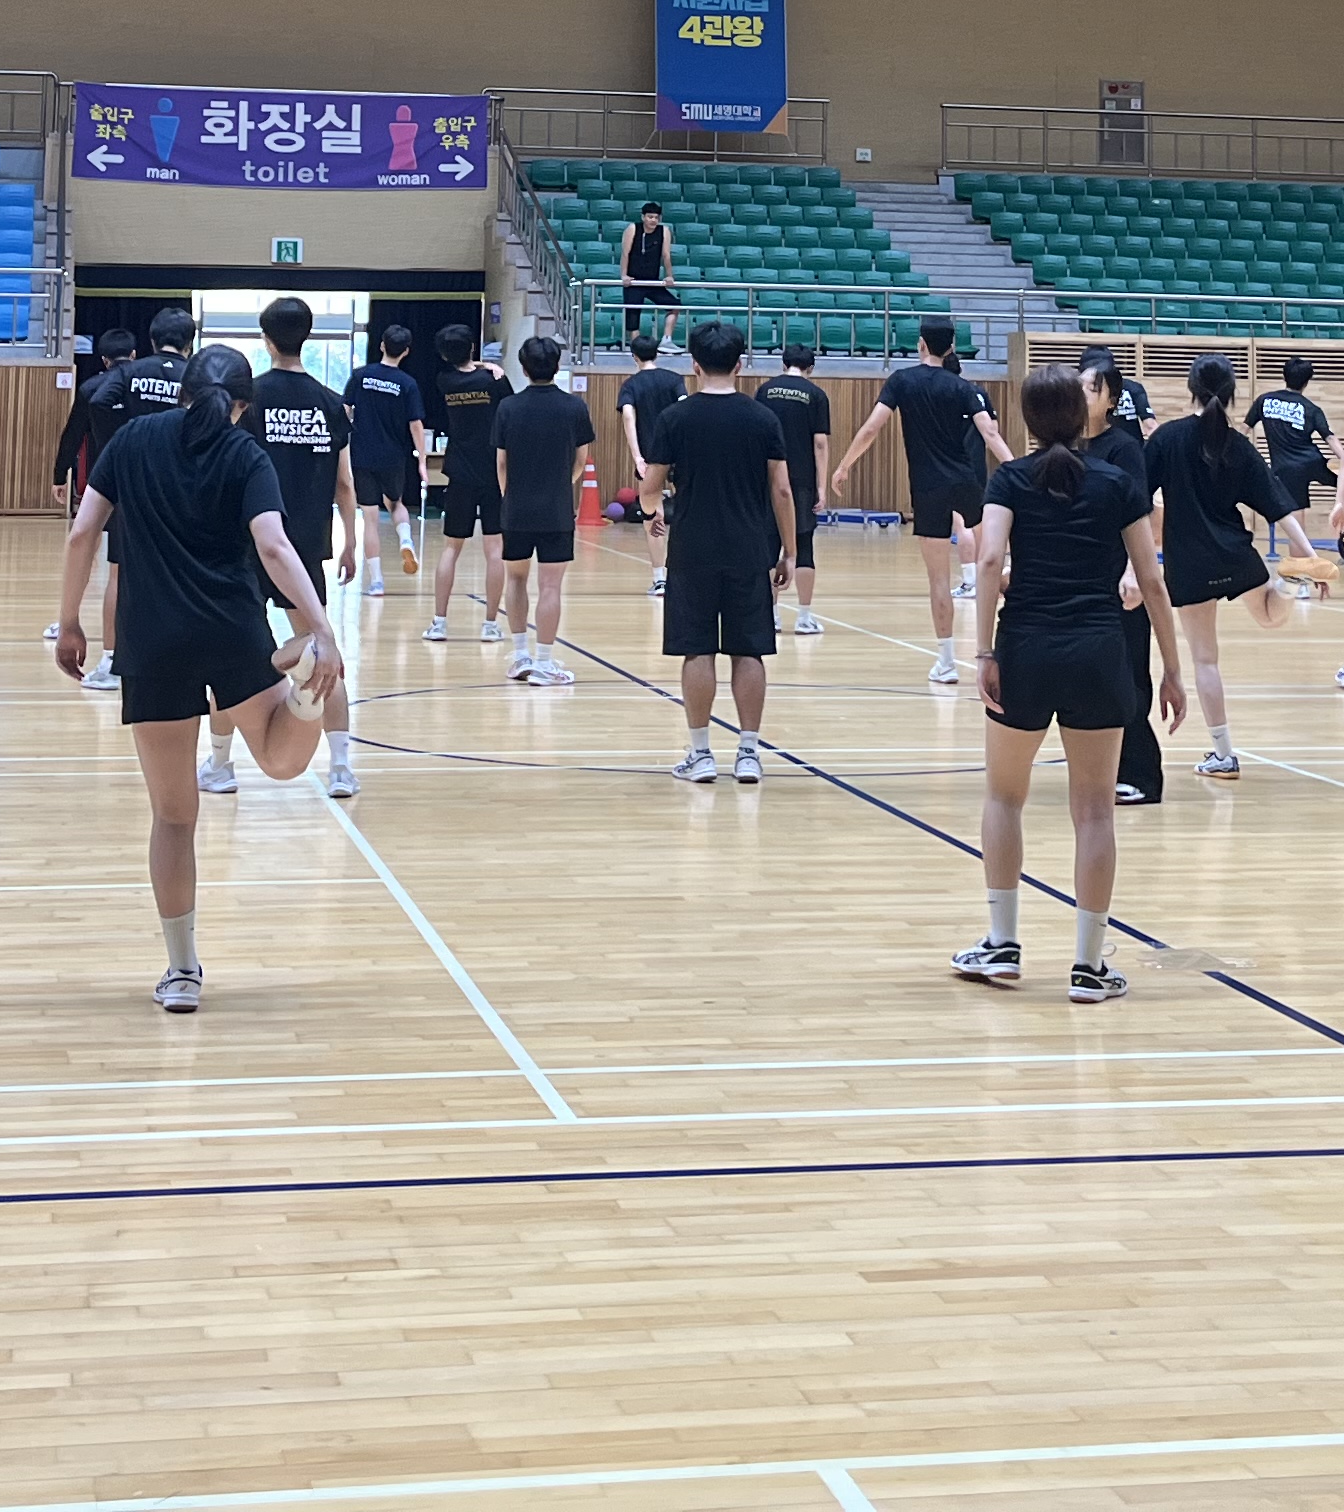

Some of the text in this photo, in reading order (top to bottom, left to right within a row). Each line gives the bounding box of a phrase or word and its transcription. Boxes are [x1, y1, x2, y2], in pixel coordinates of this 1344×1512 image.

[678, 15, 764, 48] 4관왕
[89, 103, 135, 124] 출입구
[681, 103, 713, 120] SMU
[95, 124, 127, 141] 좌측
[200, 100, 362, 154] 화장실
[433, 116, 477, 134] 출입구
[440, 134, 470, 150] 우측
[146, 168, 179, 180] man
[243, 161, 329, 184] toilet
[377, 174, 430, 185] woman
[130, 377, 182, 396] POTENT
[264, 406, 326, 424] KOREA
[265, 422, 330, 436] PHYSICAL
